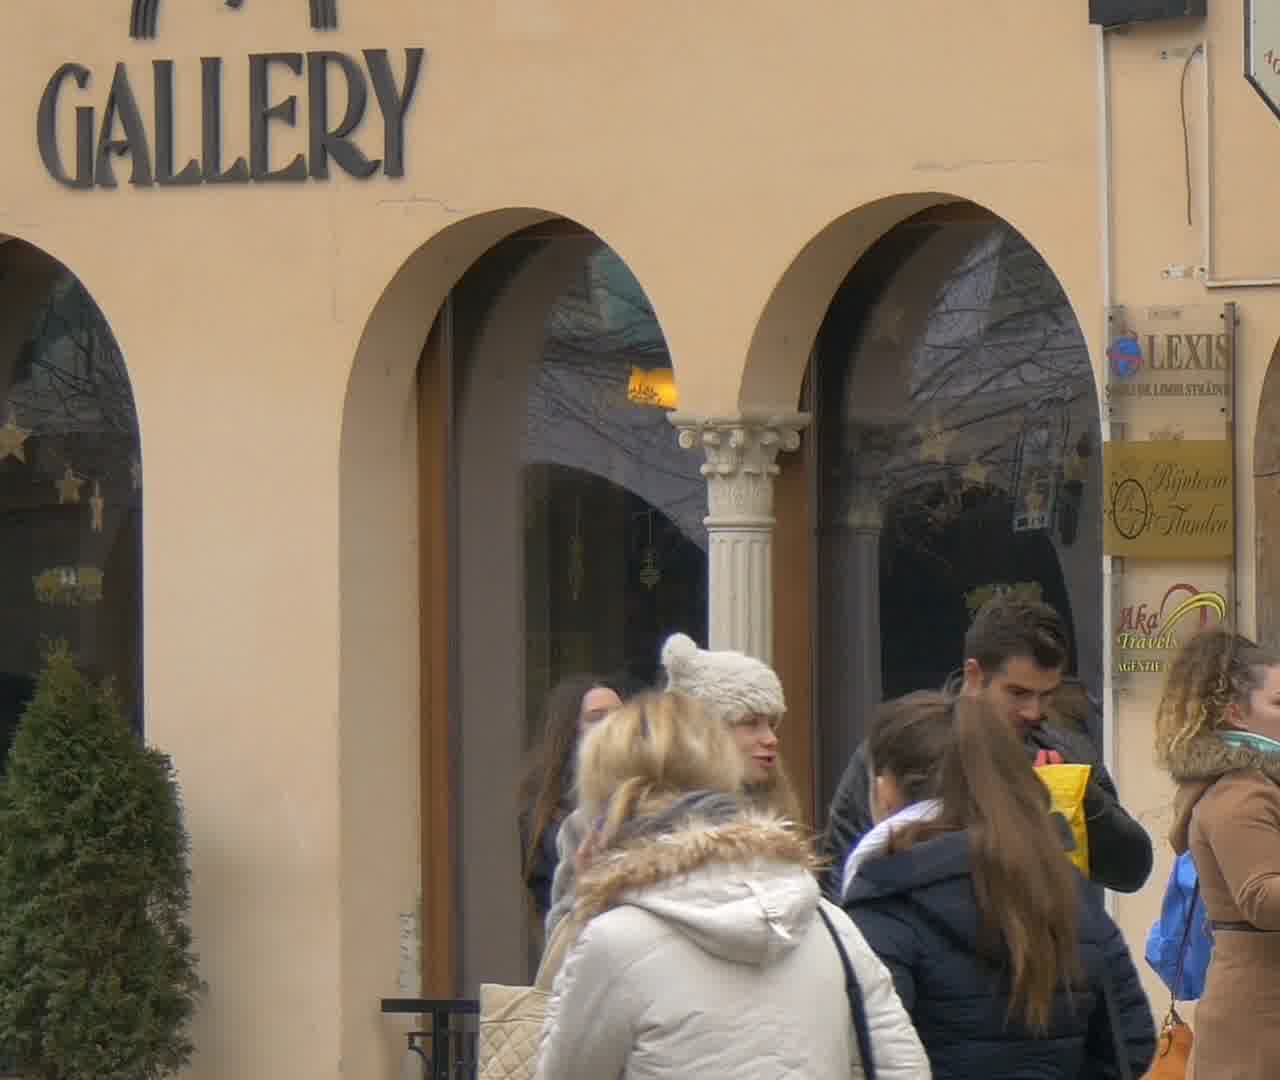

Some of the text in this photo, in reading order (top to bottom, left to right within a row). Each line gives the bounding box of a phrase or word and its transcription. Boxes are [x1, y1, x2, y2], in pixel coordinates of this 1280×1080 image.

[36, 47, 424, 190] GALLERY
[1144, 333, 1229, 370] LEXIS
[1119, 603, 1158, 634] Aka
